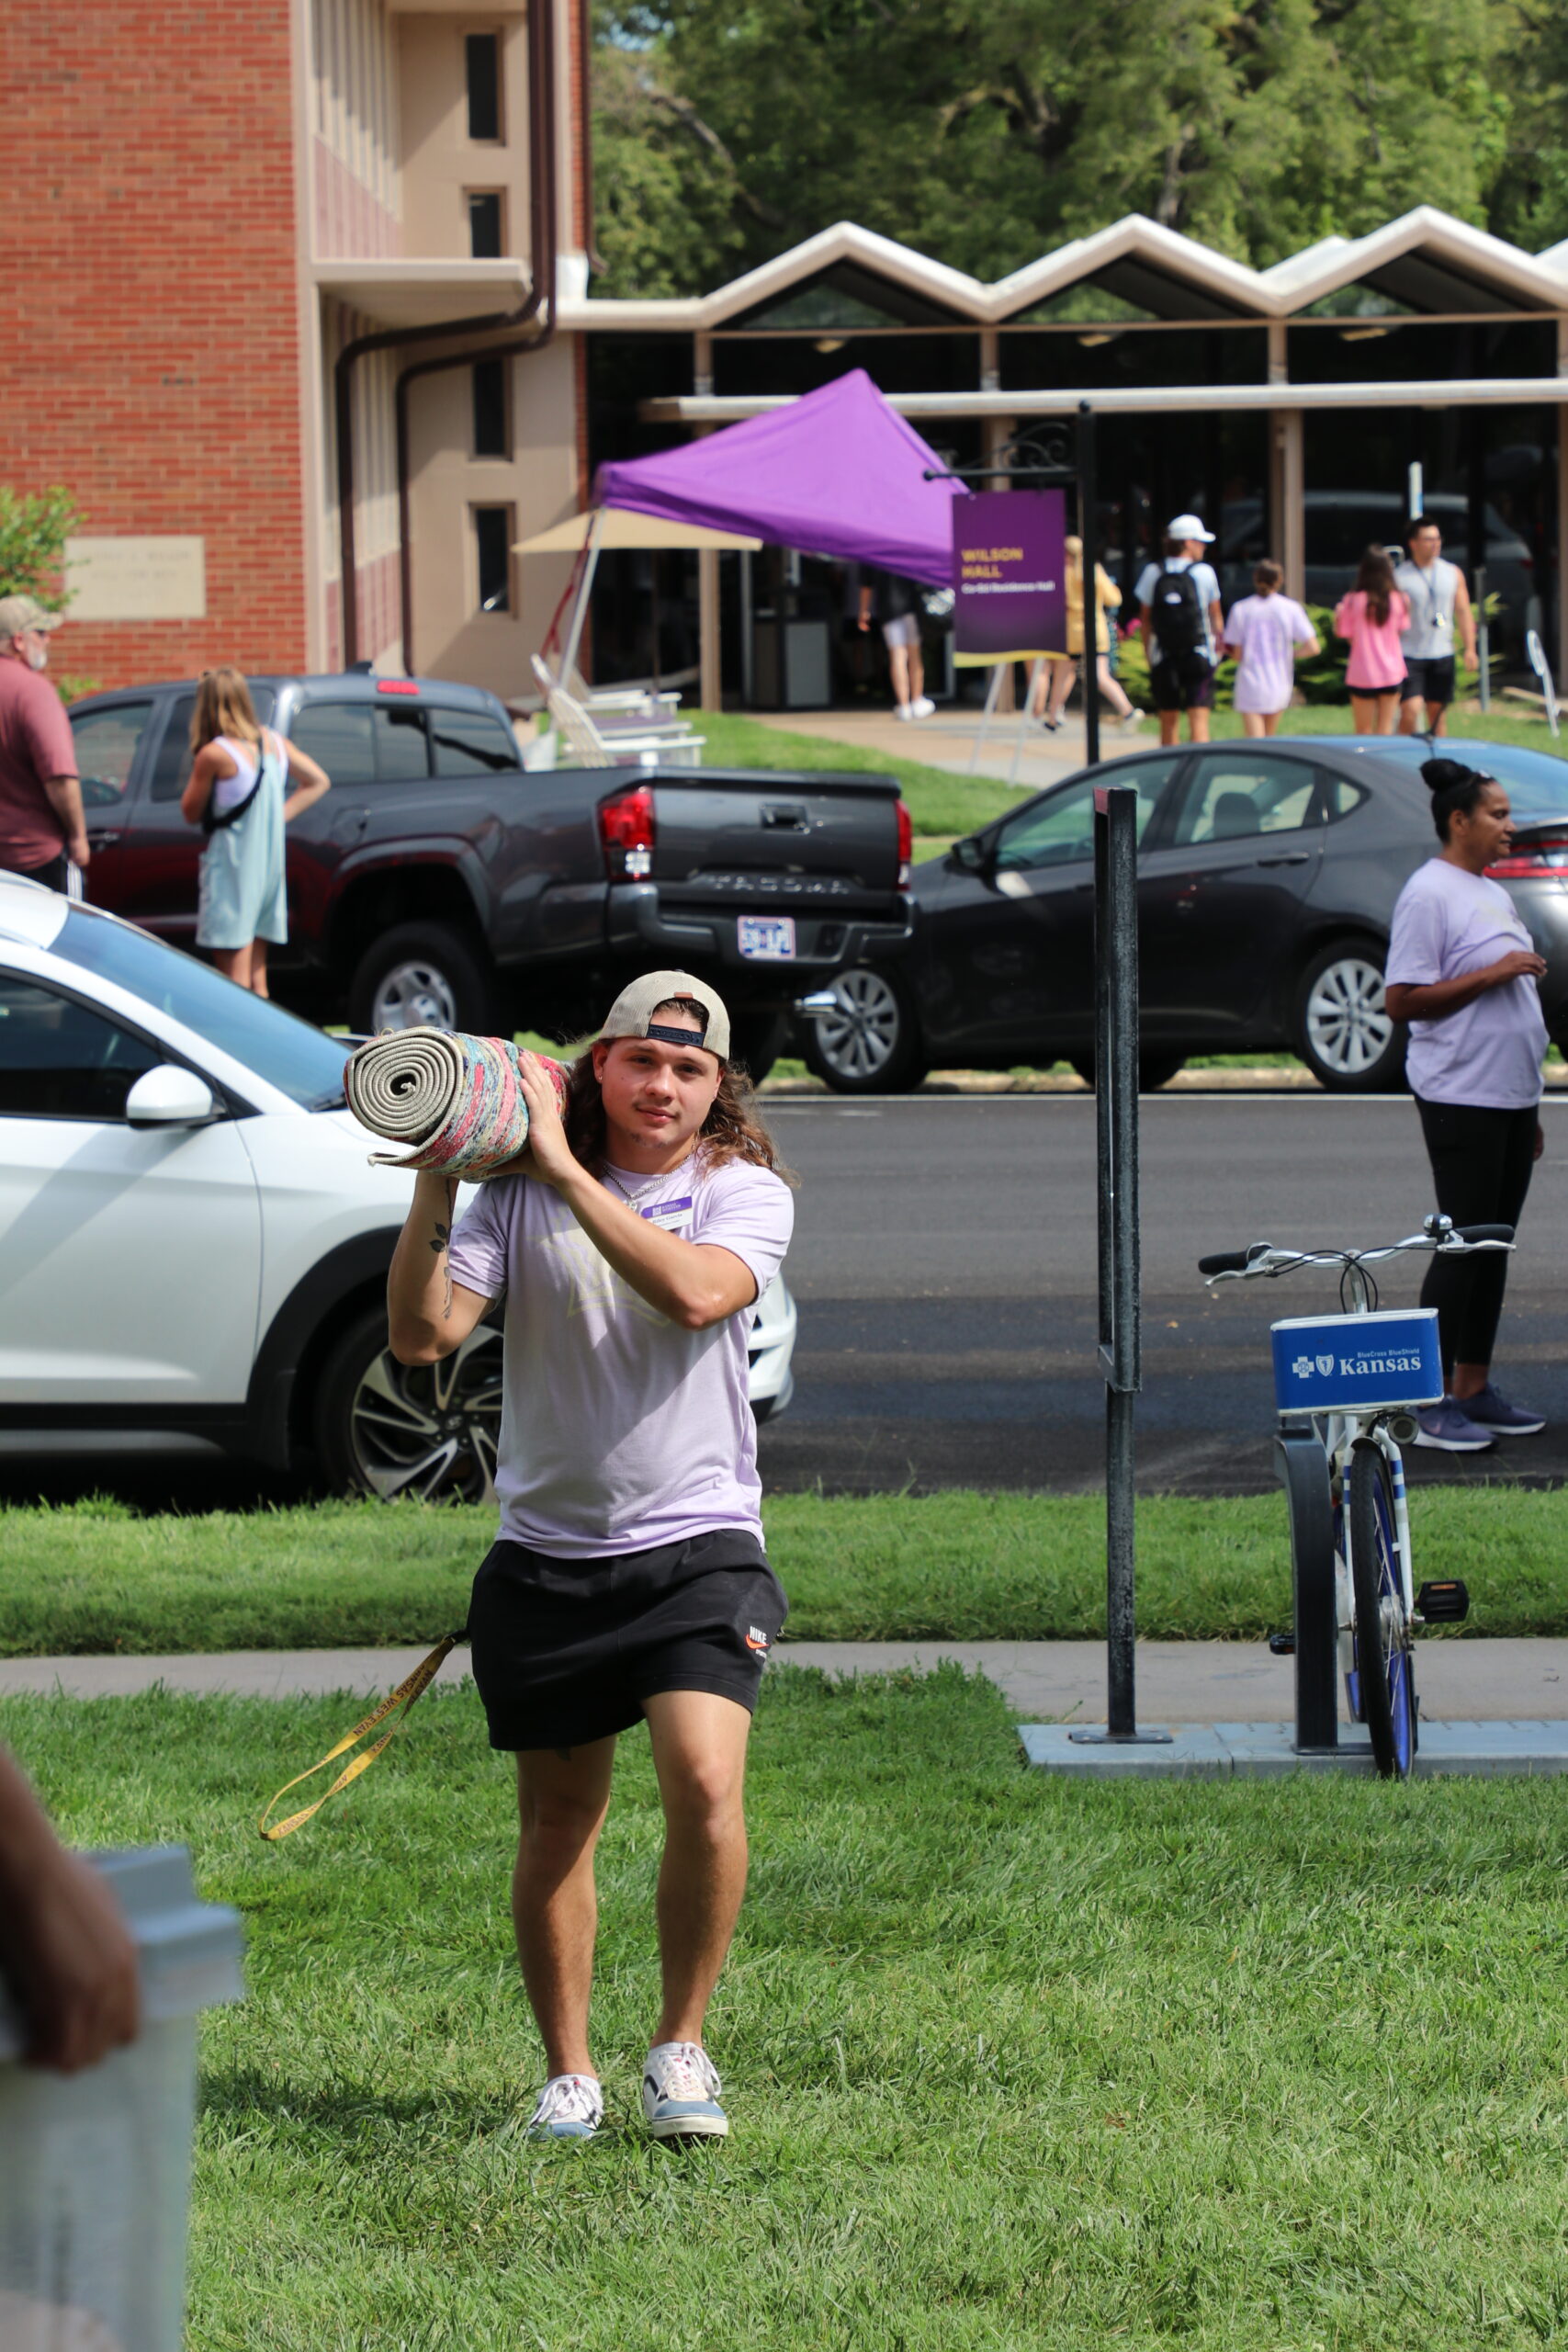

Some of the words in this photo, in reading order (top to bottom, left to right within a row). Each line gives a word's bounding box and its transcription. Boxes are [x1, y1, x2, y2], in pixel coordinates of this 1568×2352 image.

[962, 548, 1023, 562] WILSON
[962, 564, 1003, 579] HALL
[1358, 1351, 1387, 1359] BlueCross
[1389, 1348, 1420, 1357] BlueShield
[1339, 1356, 1422, 1376] Kansas
[750, 1625, 767, 1645] NIKE
[396, 1665, 424, 1699] ANSAS
